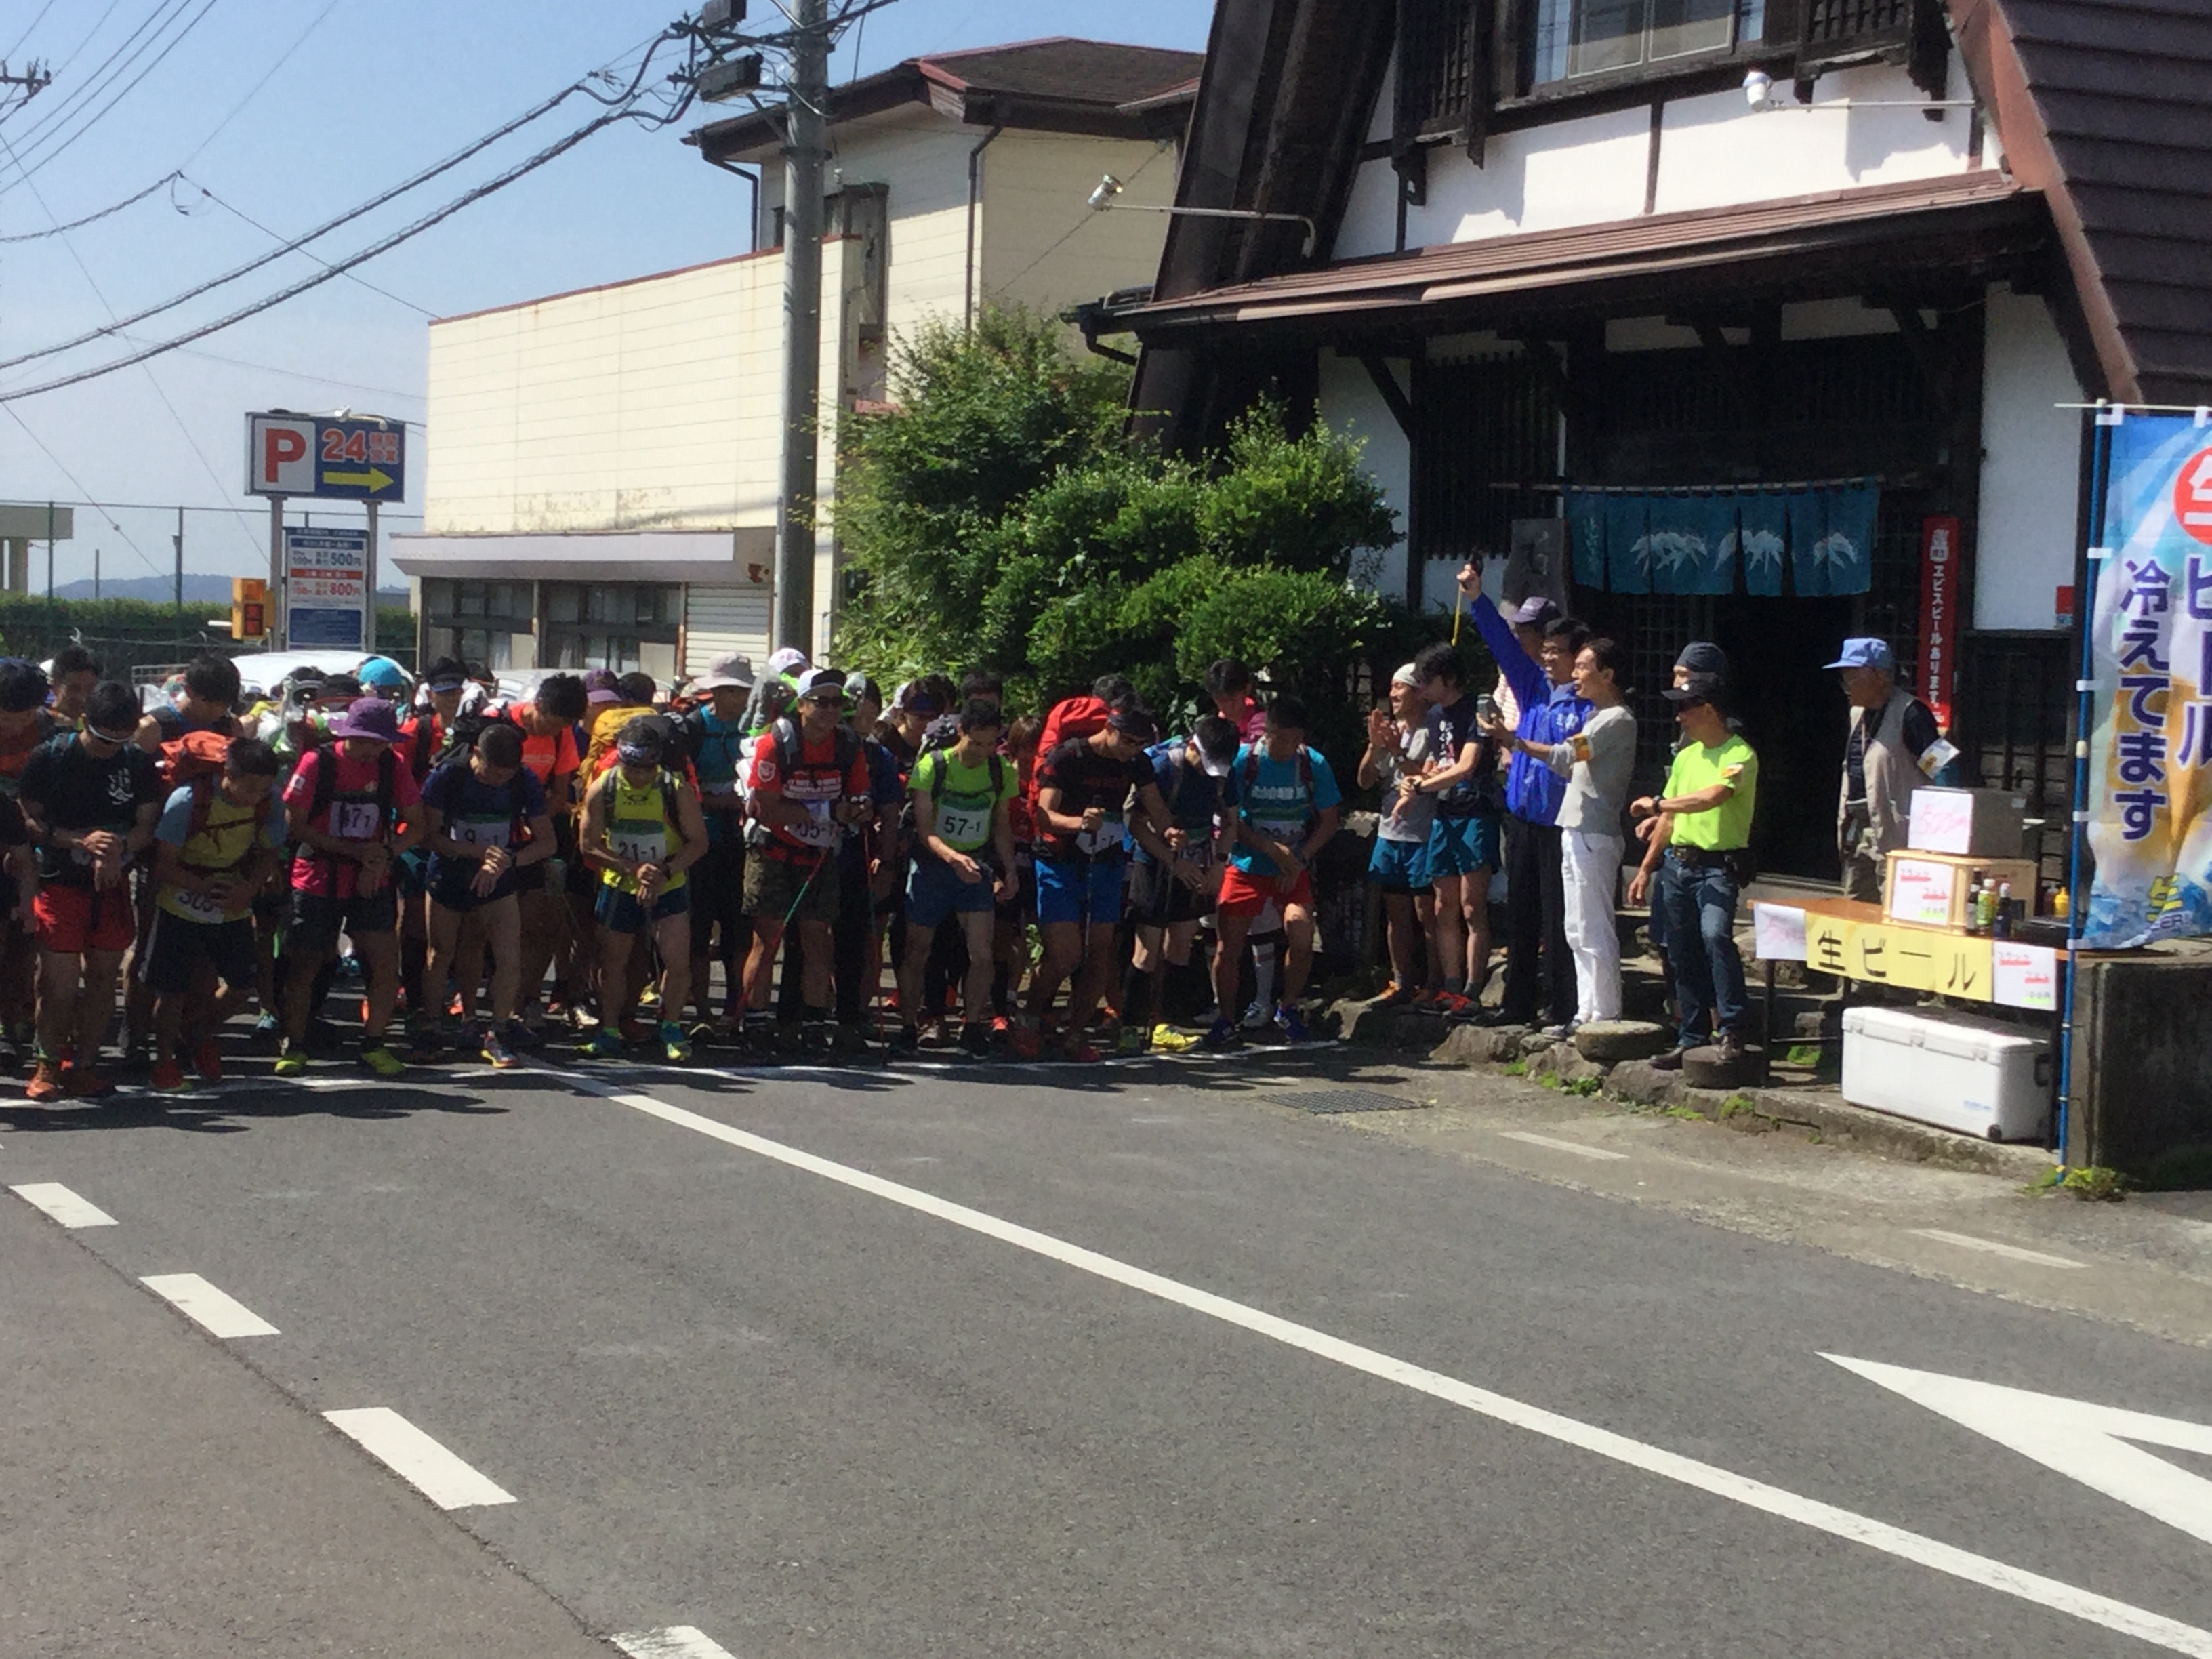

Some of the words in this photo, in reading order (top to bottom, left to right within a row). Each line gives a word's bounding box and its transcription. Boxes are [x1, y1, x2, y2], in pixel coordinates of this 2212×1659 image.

[264, 428, 307, 483] P
[321, 428, 367, 464] 24
[2114, 558, 2171, 841] 冷えてます
[943, 815, 981, 836] 57-1
[1818, 929, 1977, 991] 生ビール
